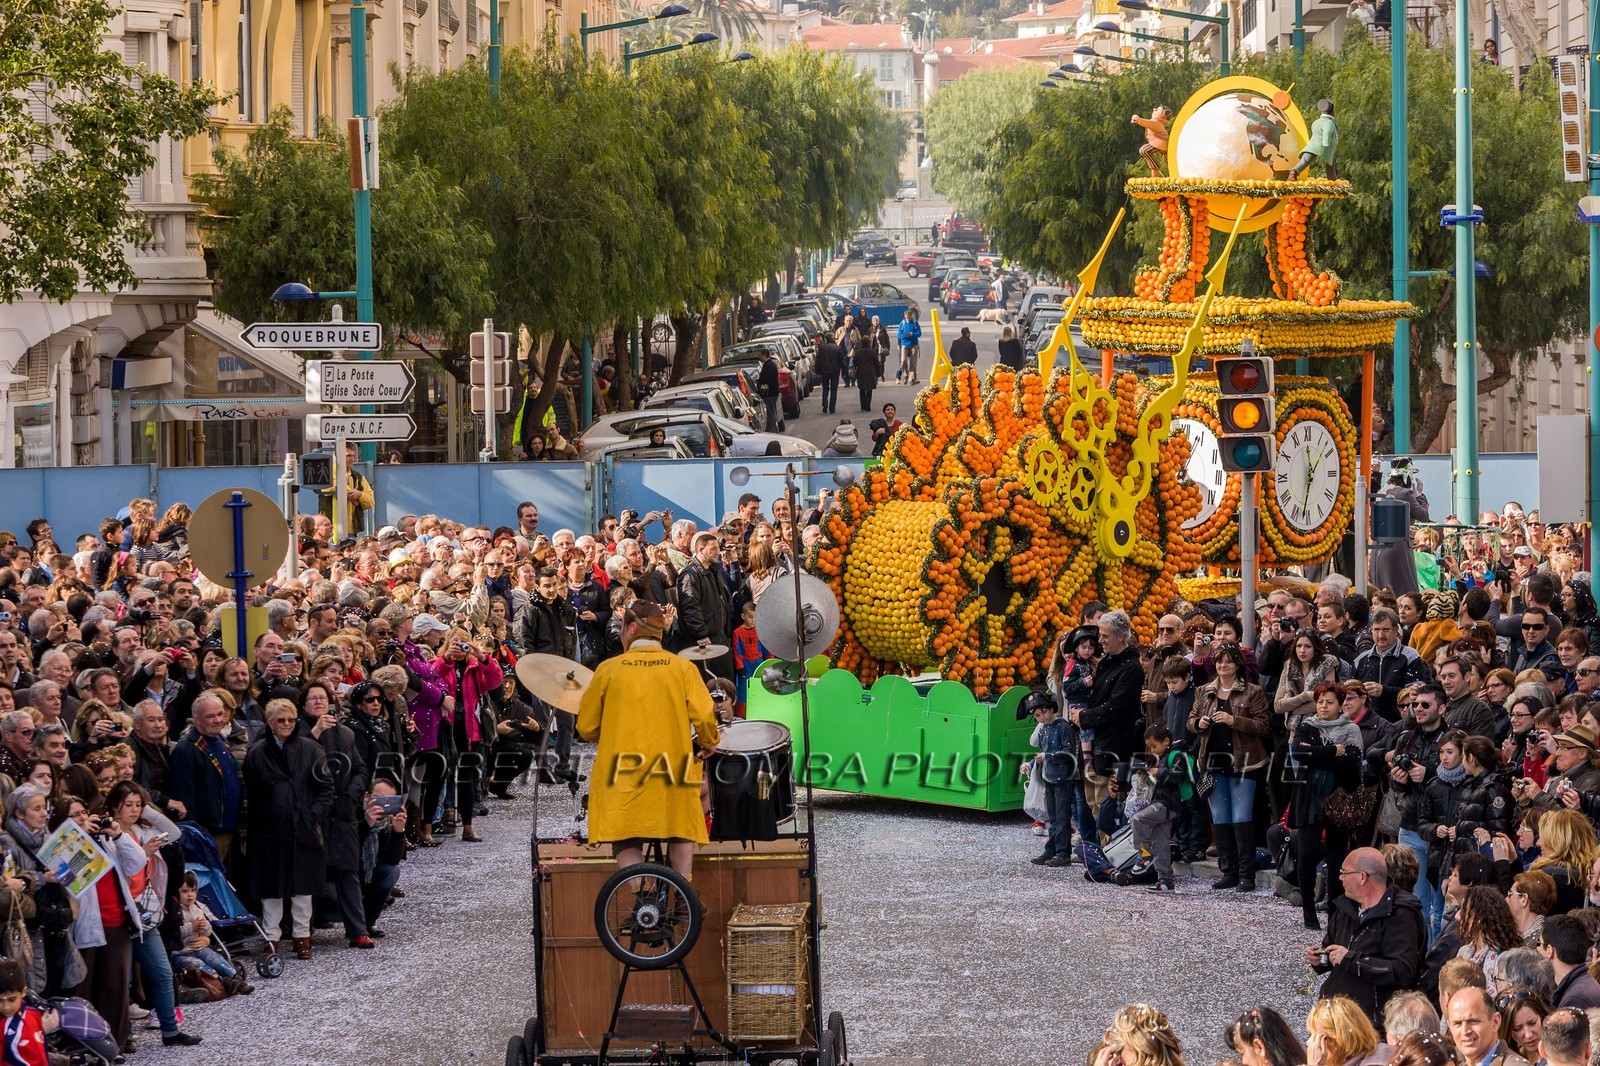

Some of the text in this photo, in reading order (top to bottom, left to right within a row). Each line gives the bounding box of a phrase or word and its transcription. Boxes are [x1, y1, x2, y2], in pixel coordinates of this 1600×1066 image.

[257, 330, 371, 343] ROQUEBRUNE
[337, 368, 374, 380] La Poste
[325, 383, 402, 399] Eglise Sacré Coeur
[324, 421, 385, 434] Gare S.N.C.F.
